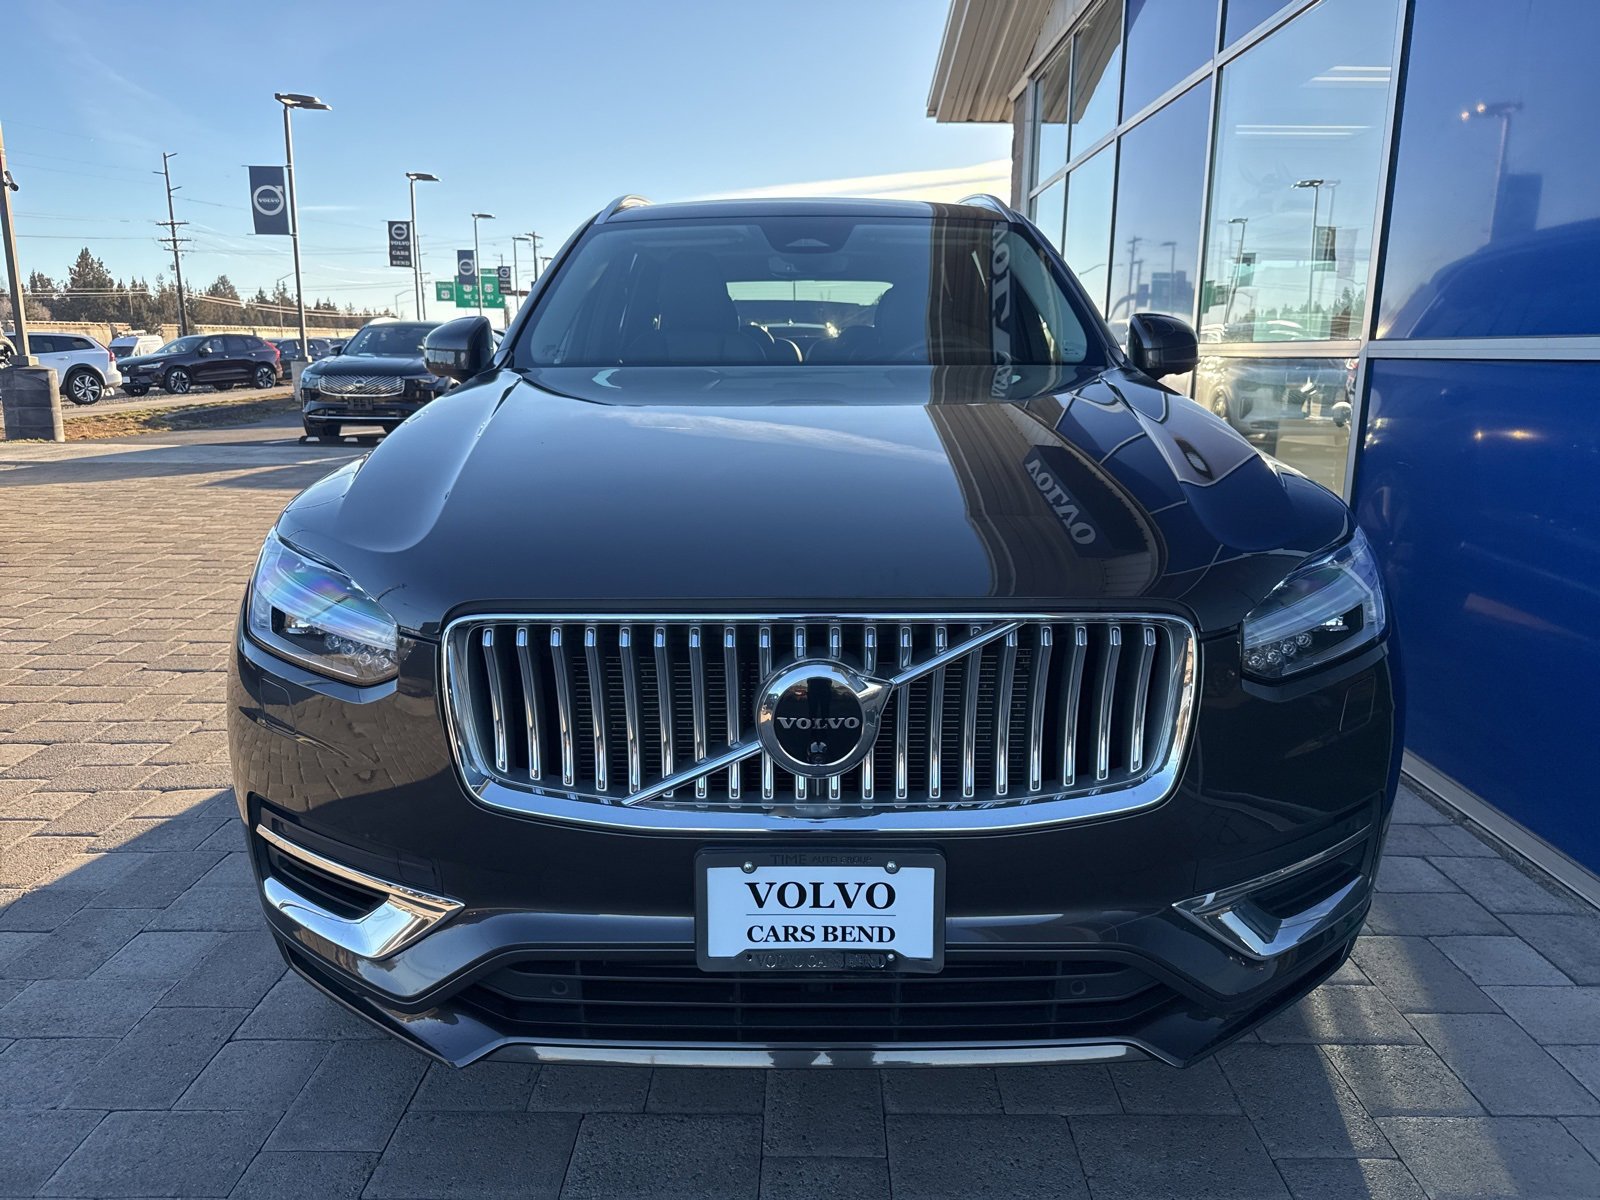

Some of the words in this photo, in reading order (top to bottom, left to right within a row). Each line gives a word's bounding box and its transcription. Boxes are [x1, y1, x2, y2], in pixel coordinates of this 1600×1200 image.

[777, 717, 860, 730] VOLVO
[769, 854, 807, 865] TIME
[744, 881, 896, 910] VOLVO
[746, 924, 816, 943] CARS
[821, 925, 896, 943] BEND
